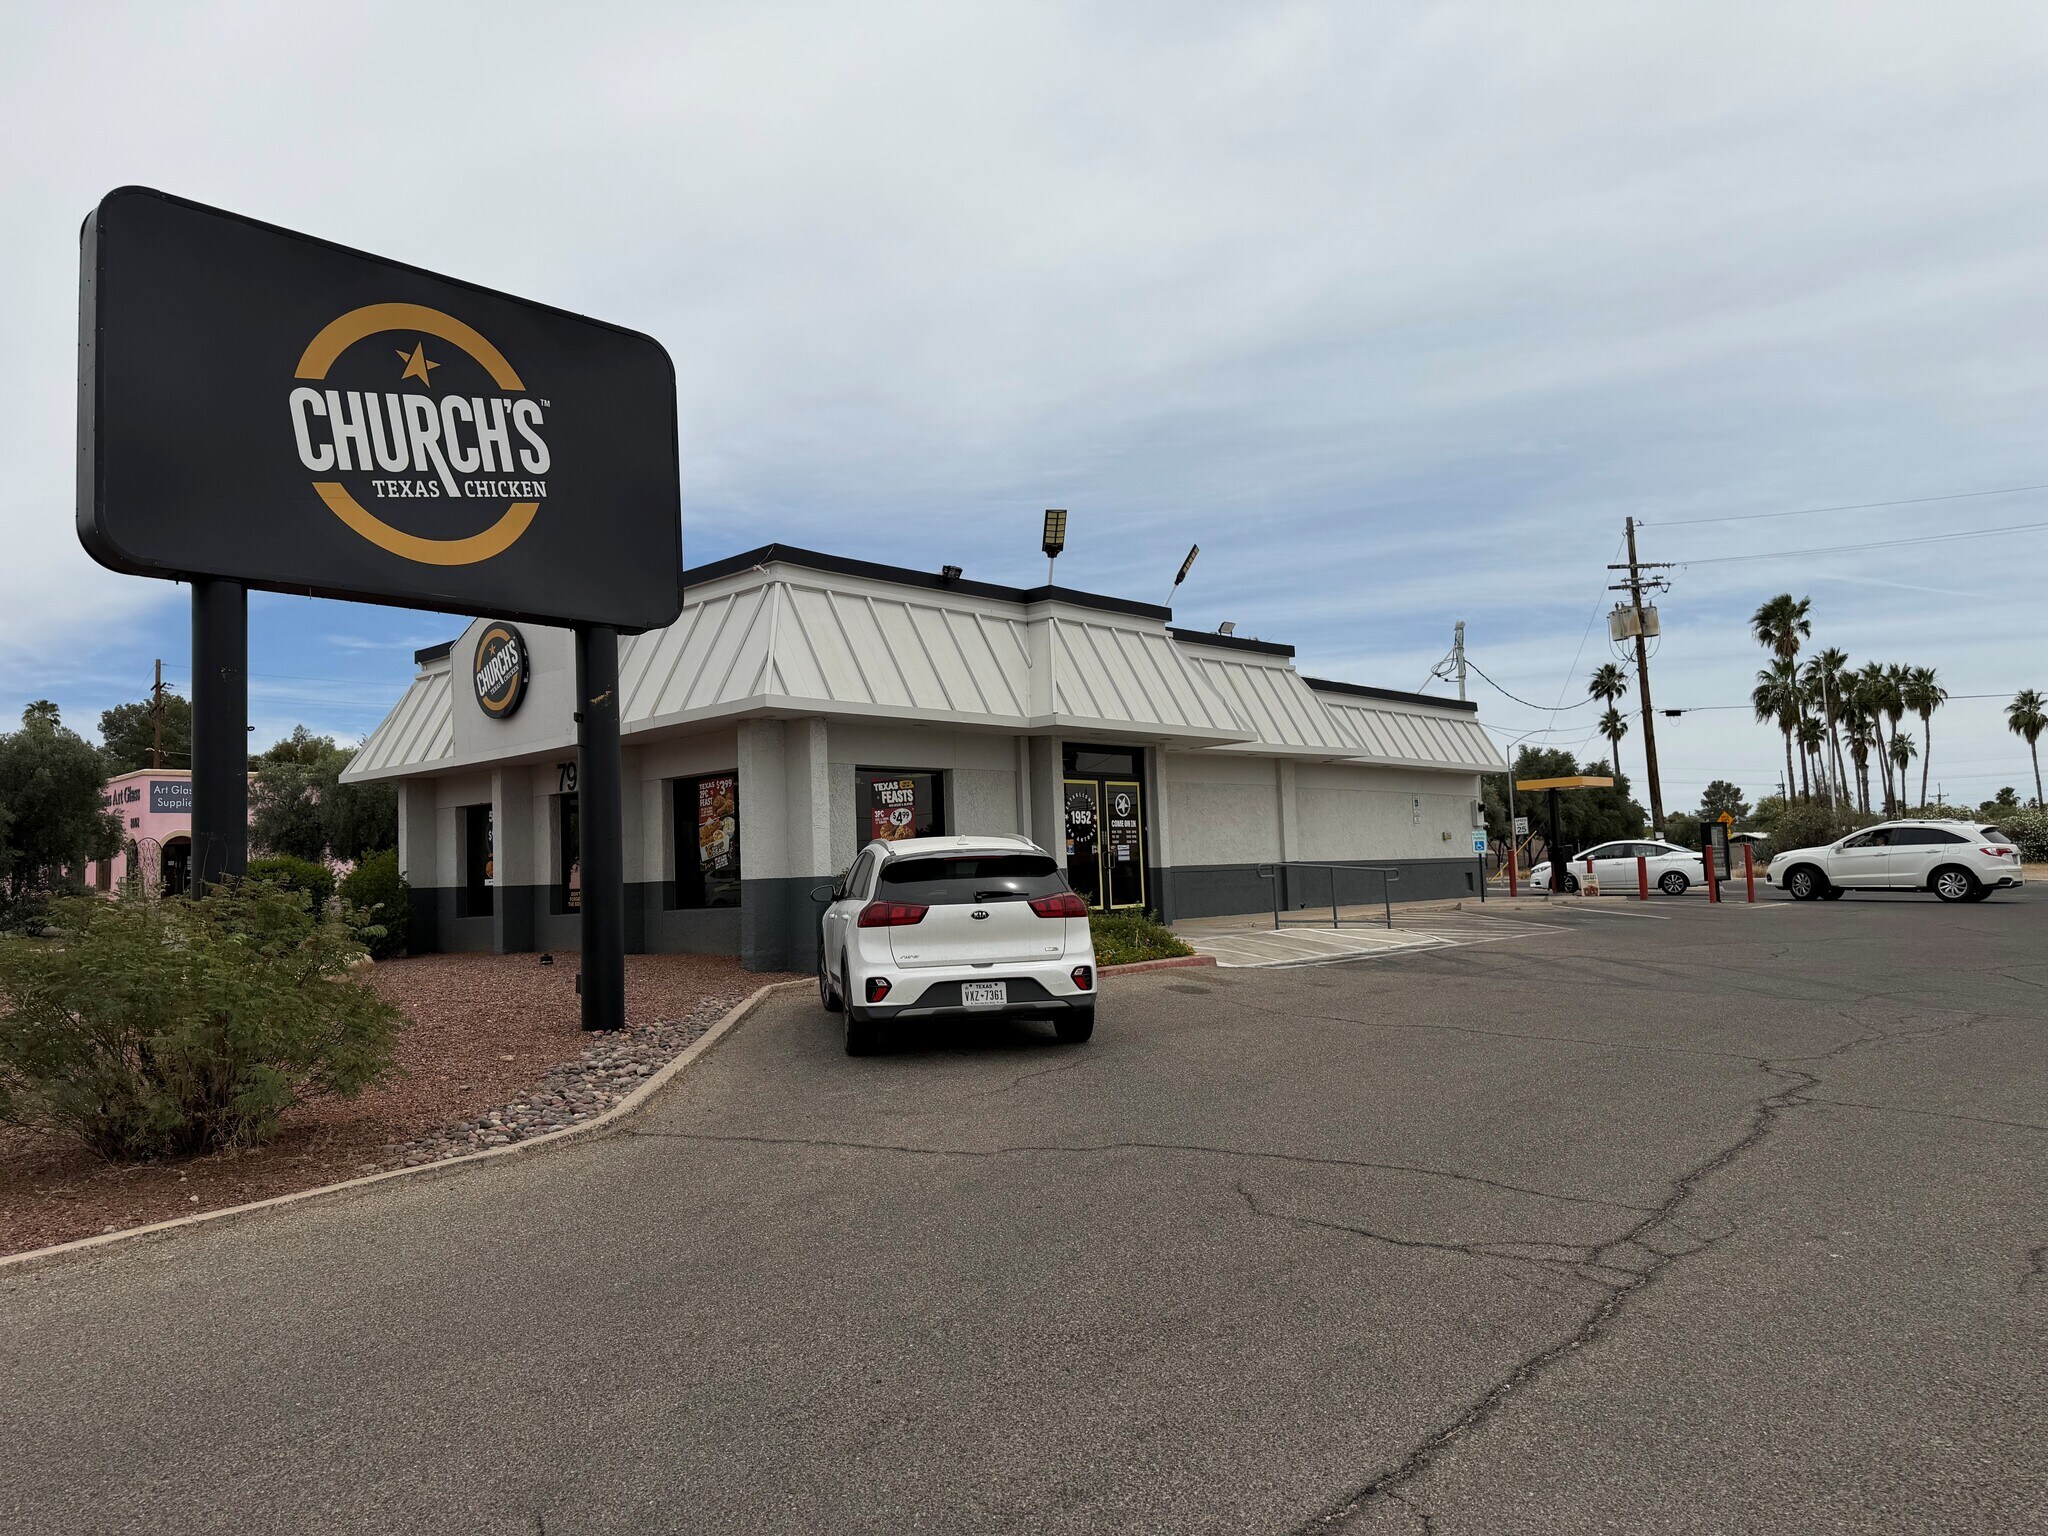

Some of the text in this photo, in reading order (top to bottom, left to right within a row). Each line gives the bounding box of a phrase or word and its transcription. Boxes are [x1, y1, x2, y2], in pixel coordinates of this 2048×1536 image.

[289, 387, 551, 498] CHURCH'S
[372, 480, 548, 498] TEXAS CHICKEN
[476, 639, 519, 697] CHURCH'S
[153, 785, 192, 795] Art Glas
[699, 781, 715, 790] TEXAS
[873, 781, 899, 792] TEXAS
[113, 789, 124, 806] Art
[157, 797, 192, 809] Supplie
[881, 789, 914, 804] FEASTS
[1070, 810, 1092, 825] 1952
[1517, 825, 1527, 833] 25
